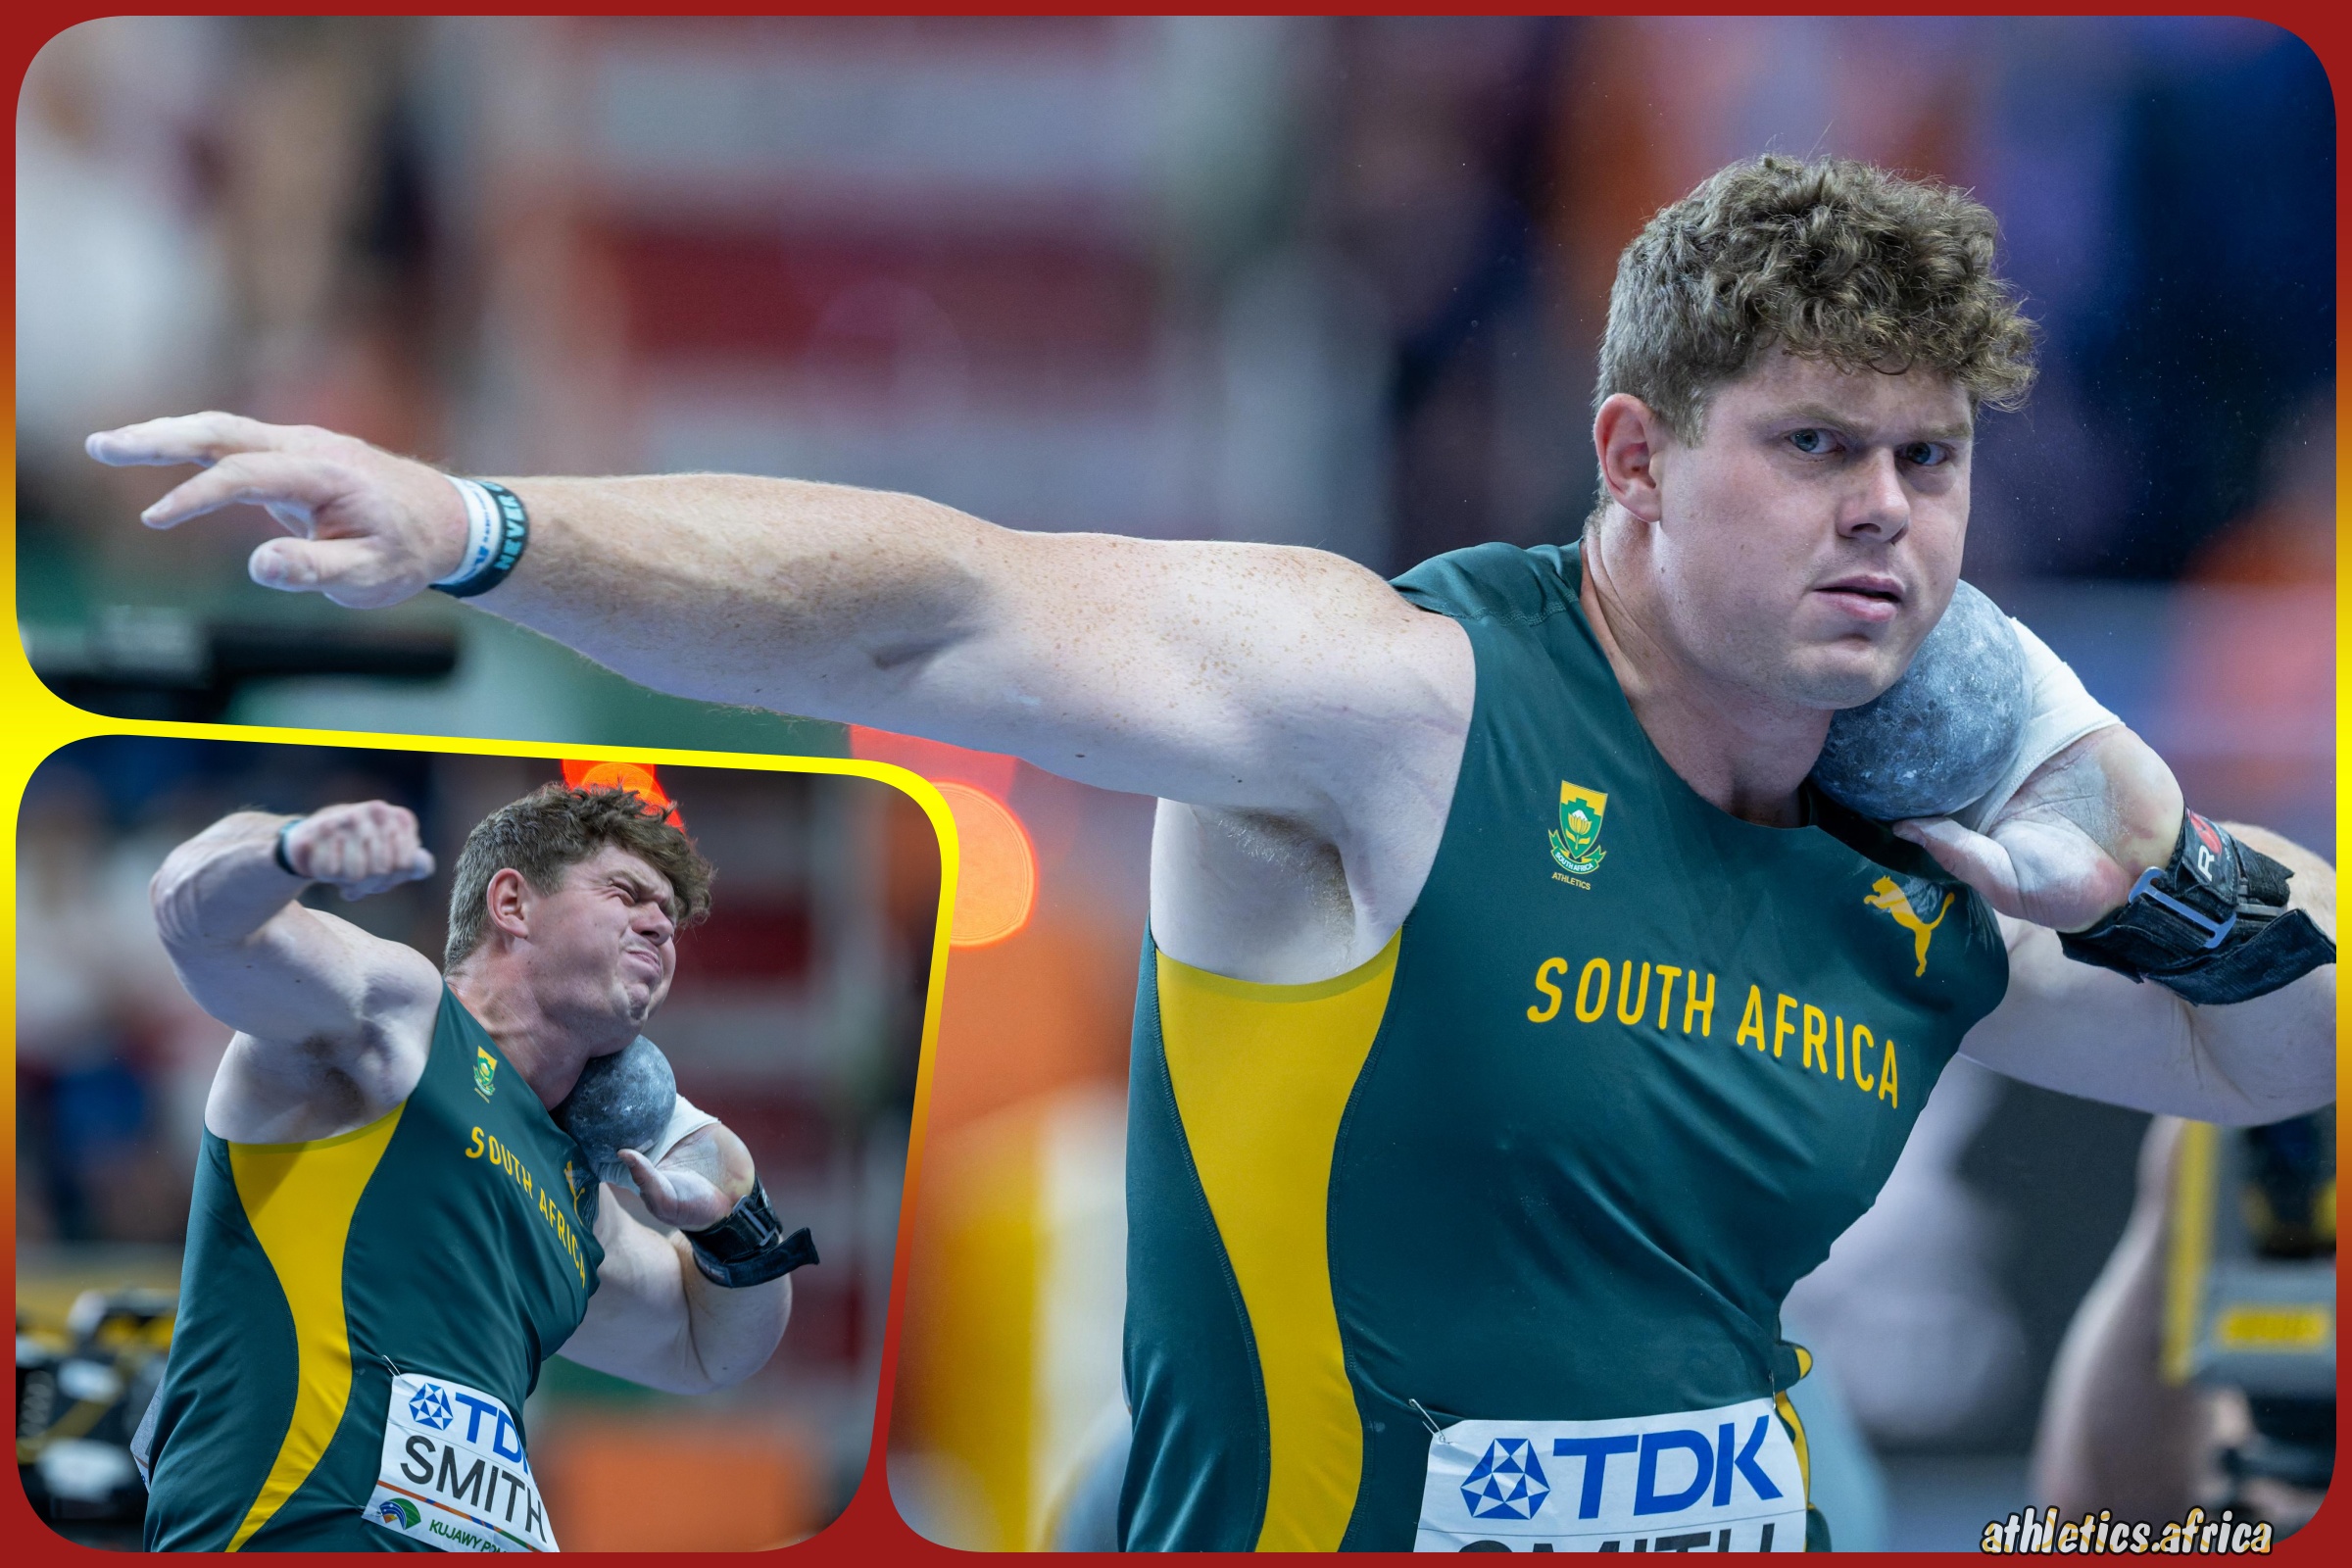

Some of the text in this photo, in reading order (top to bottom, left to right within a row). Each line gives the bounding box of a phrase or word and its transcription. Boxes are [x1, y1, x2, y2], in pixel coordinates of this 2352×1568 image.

[1552, 872, 1592, 890] ATHLETICS
[1555, 852, 1593, 872] SOUTH AFRICA
[1527, 956, 1898, 1109] SOUTH AFRICA
[465, 1125, 587, 1290] SOUTH AFRICA
[455, 1392, 529, 1476] TD
[1552, 1414, 1785, 1520] TDK
[400, 1434, 548, 1545] SMITH
[429, 1519, 483, 1549] KUJAWY
